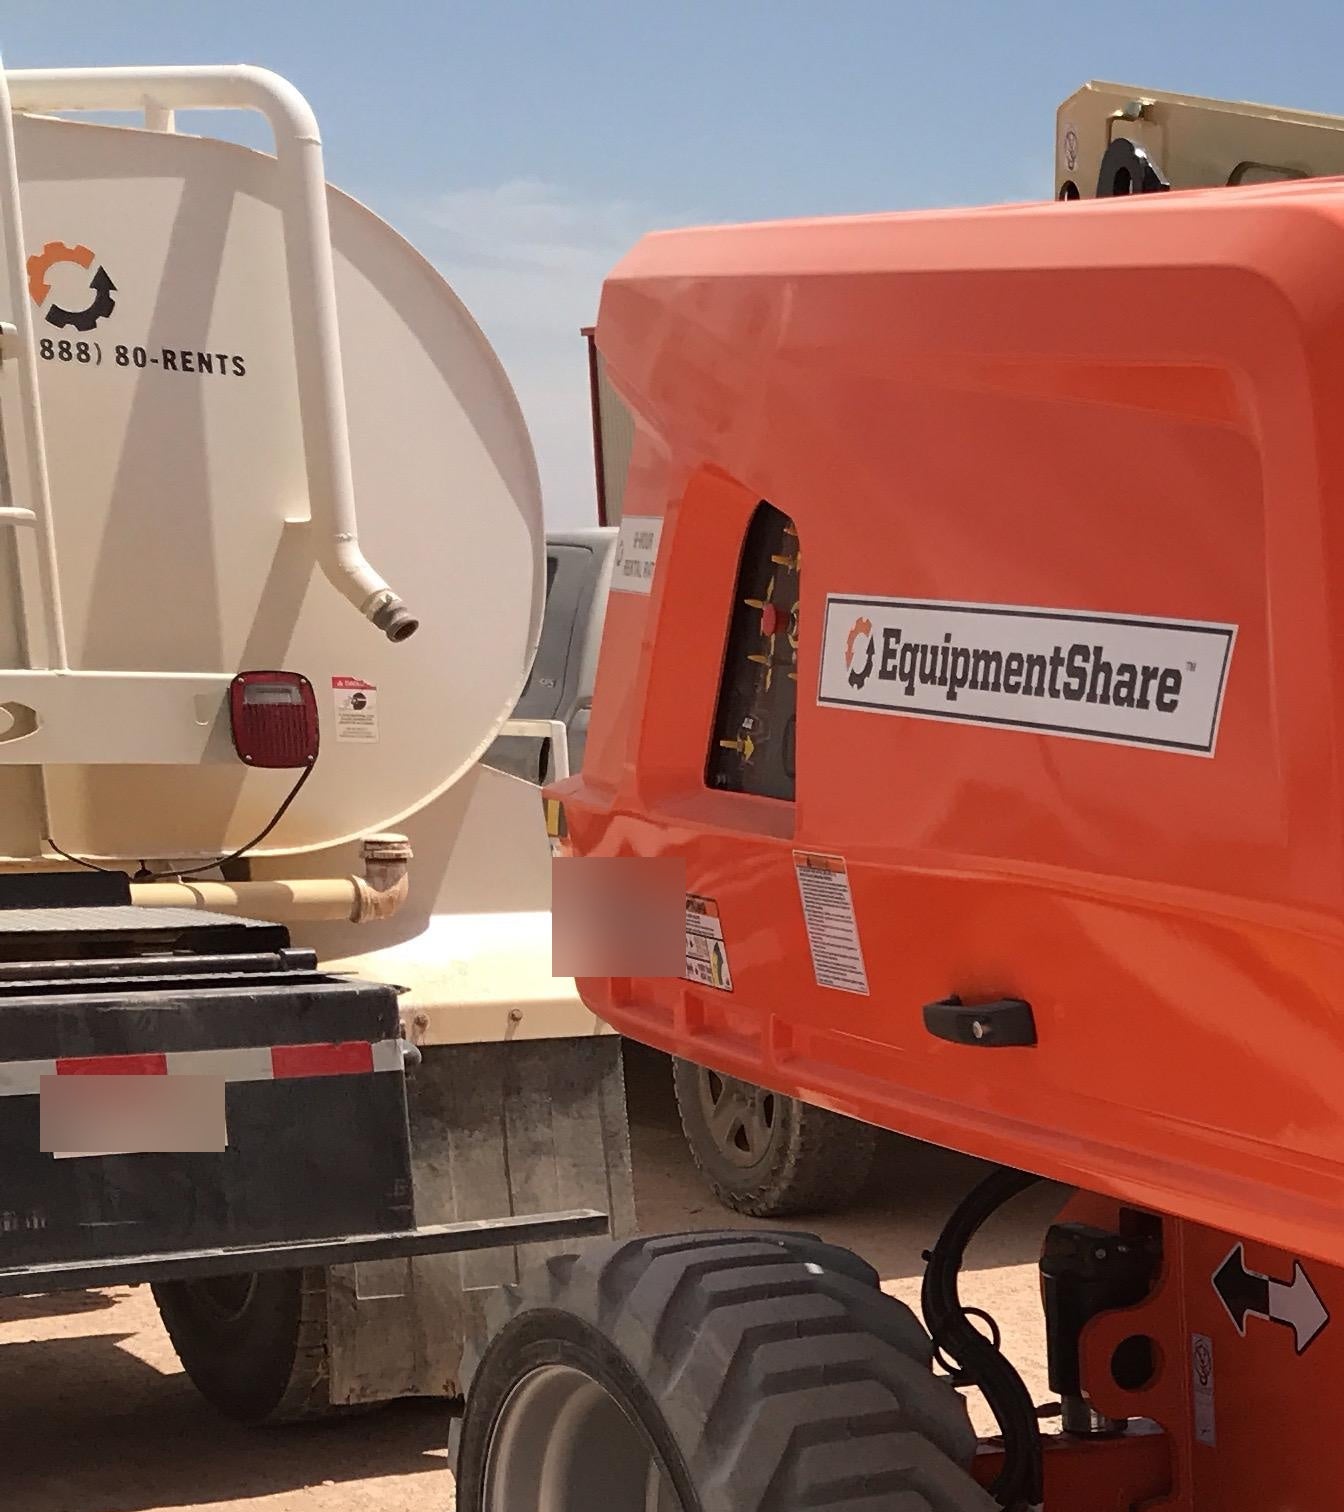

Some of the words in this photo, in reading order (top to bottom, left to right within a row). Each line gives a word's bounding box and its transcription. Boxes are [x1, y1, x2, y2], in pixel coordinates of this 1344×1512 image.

[38, 338, 102, 366] 888)
[114, 344, 247, 377] 80-RENTS
[879, 627, 1183, 713] EquipmentShare
